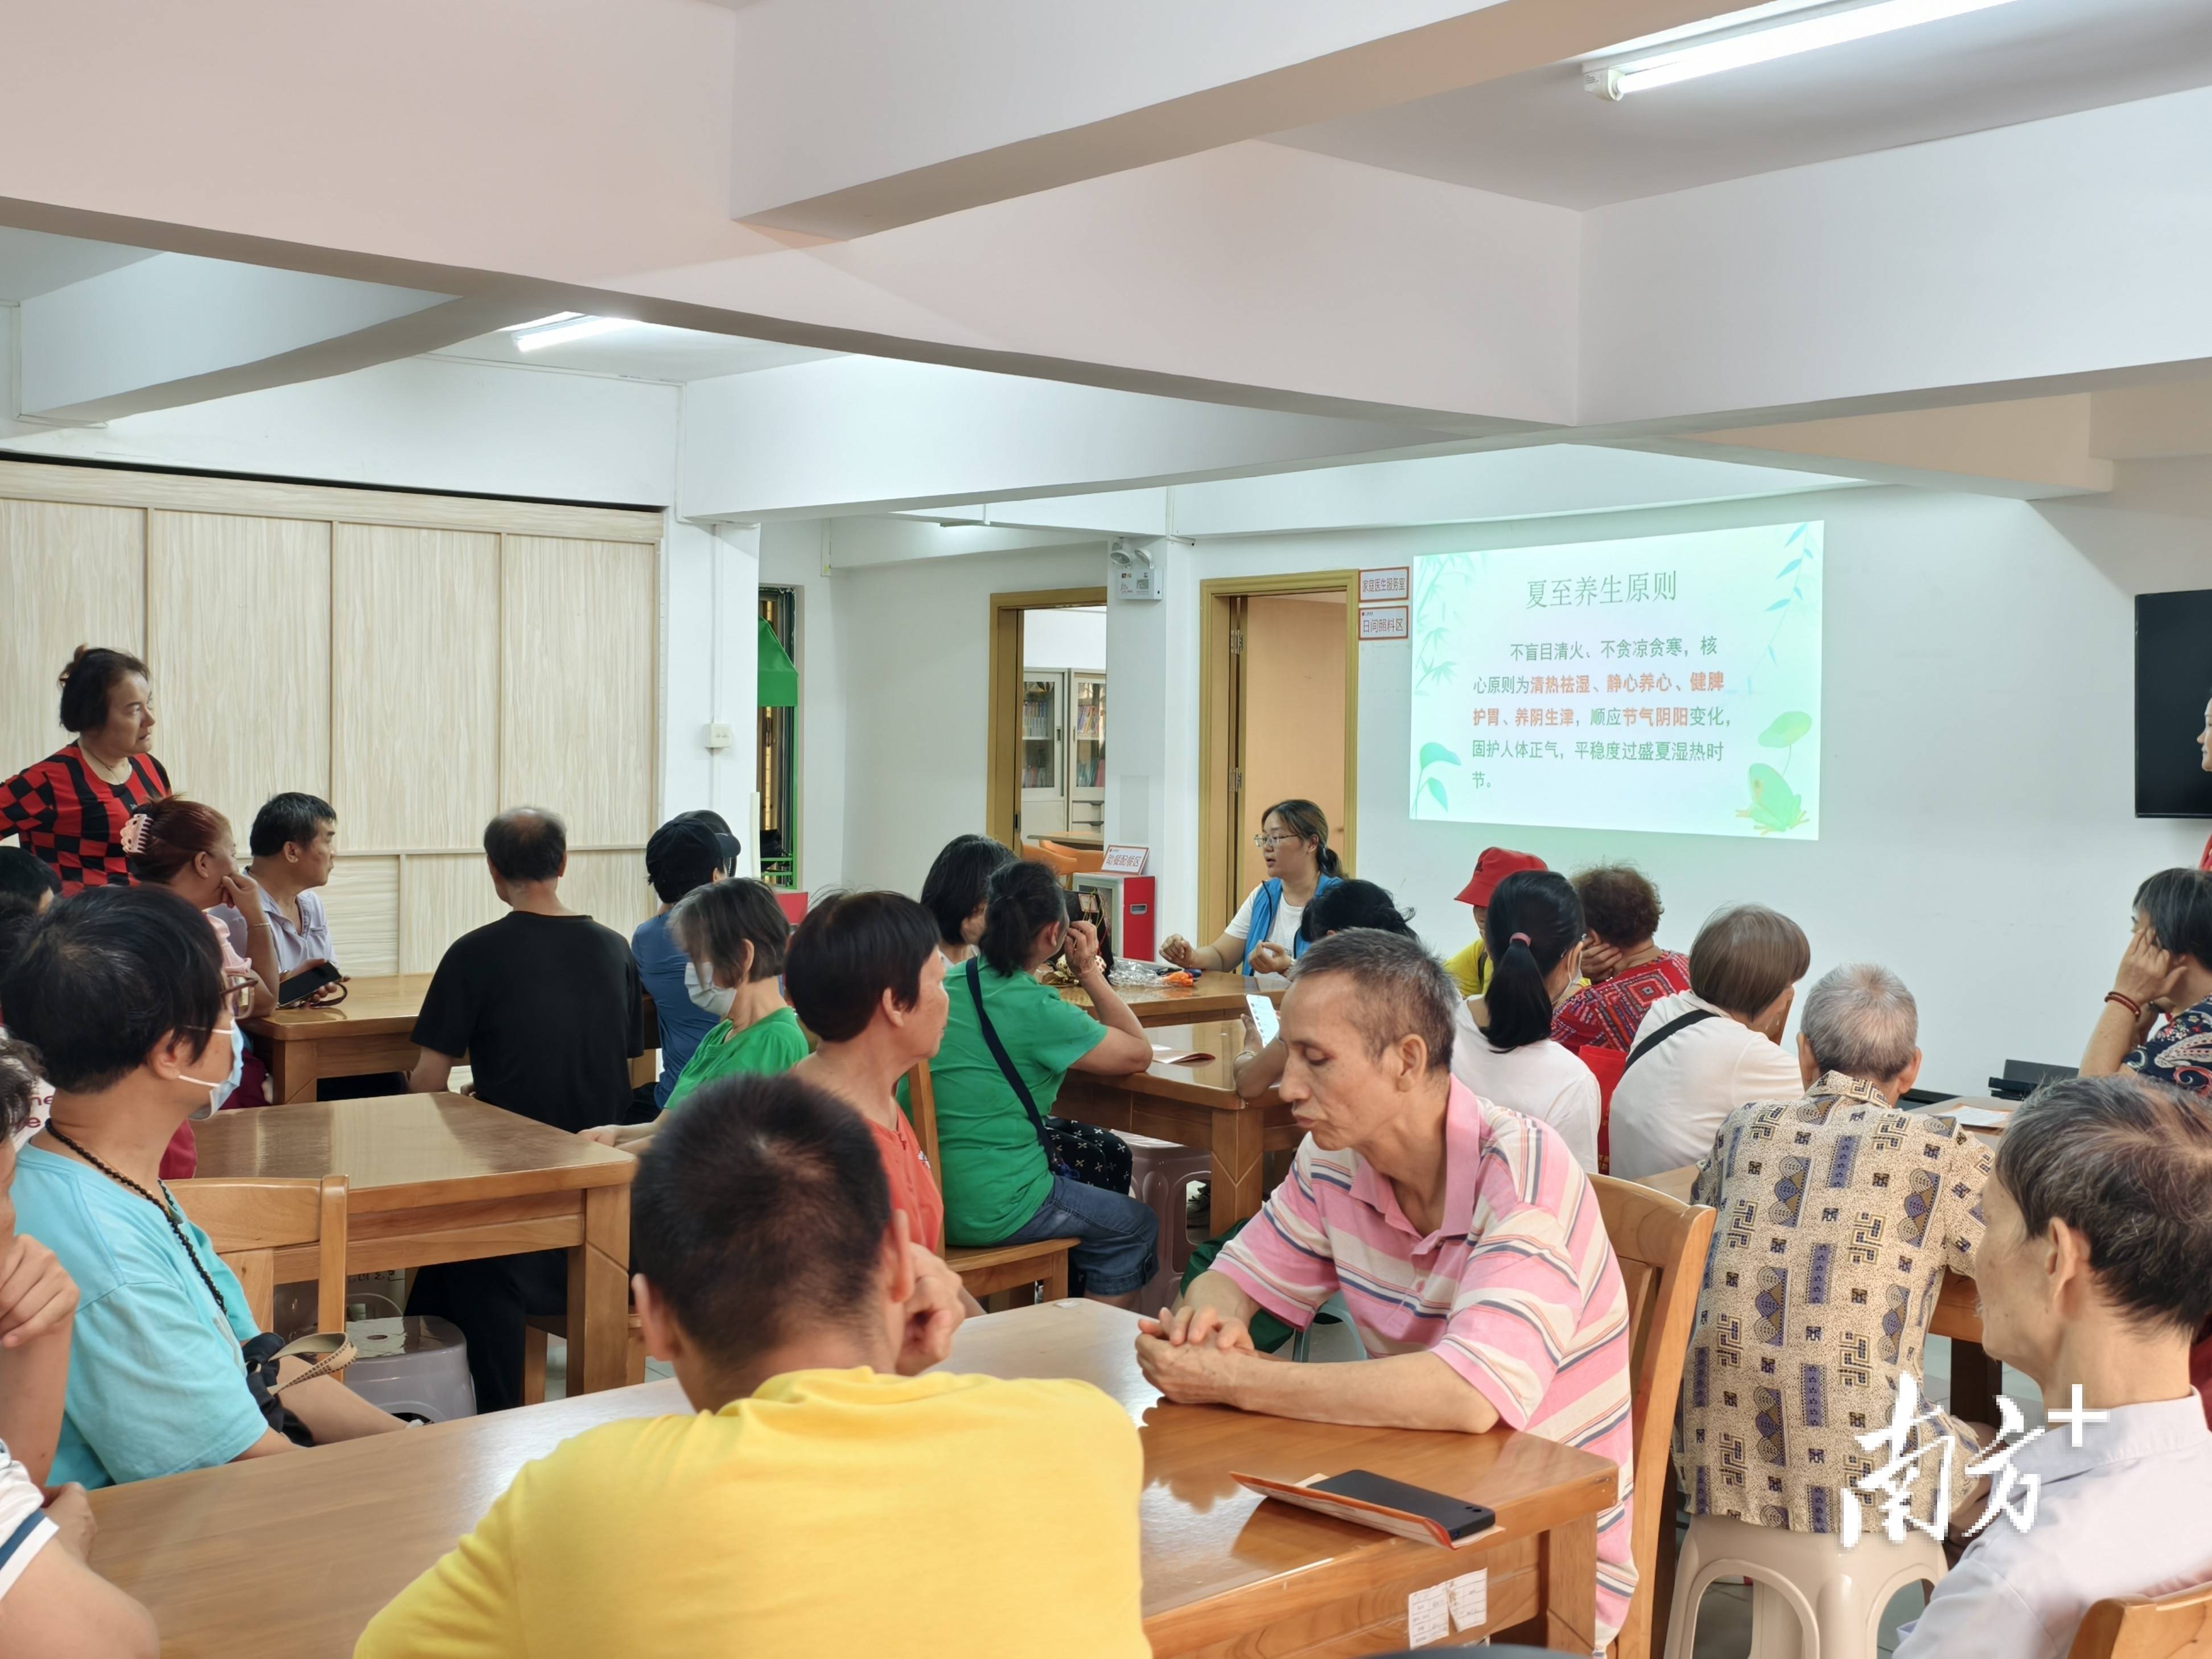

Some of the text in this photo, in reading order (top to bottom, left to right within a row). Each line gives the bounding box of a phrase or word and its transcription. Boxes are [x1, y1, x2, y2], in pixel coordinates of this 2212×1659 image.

[1363, 578, 1406, 592] 家庭医生服务室
[1526, 570, 1676, 610] 夏至养生原则
[1364, 618, 1404, 633] 日间照料区
[1510, 635, 1717, 661] 不盲目清火、不贪凉贪寒，核
[1473, 671, 1724, 694] 心原则为清热祛湿、静心养心、健脾
[1473, 706, 1730, 727] 护胃、养阴生津，顺应节气阴阳变化，
[1472, 740, 1724, 761] 固护人体正气，平稳度过盛夏湿热时
[1472, 771, 1492, 789] 节。
